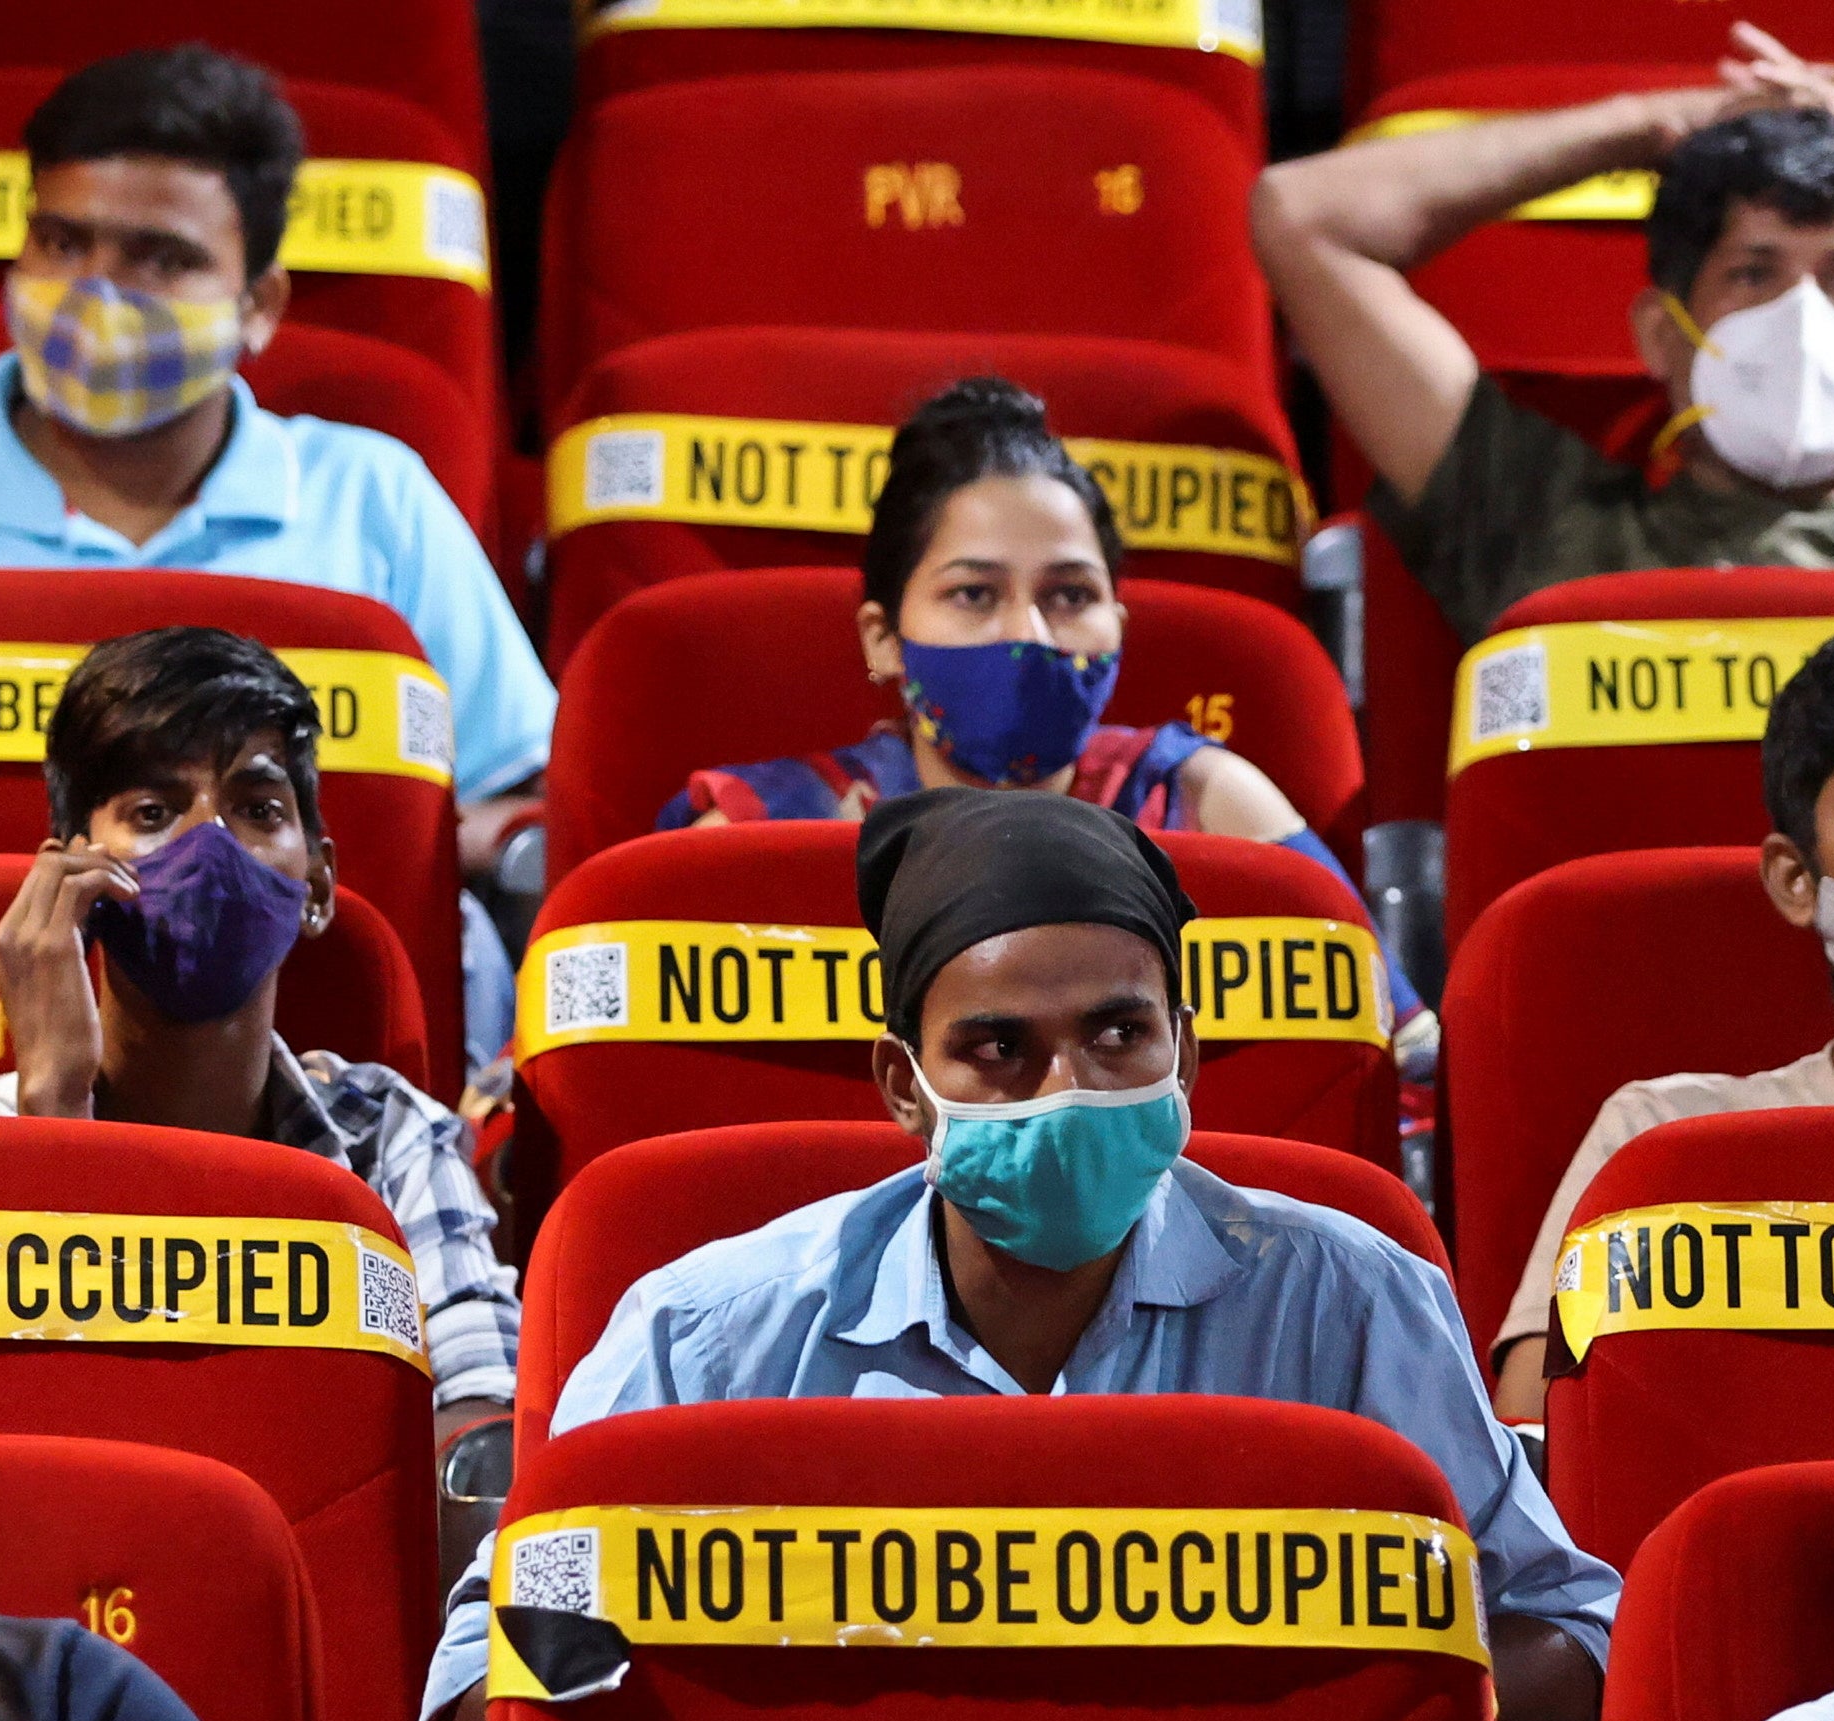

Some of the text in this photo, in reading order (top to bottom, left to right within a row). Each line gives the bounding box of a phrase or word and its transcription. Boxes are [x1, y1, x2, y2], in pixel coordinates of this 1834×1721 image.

[288, 187, 394, 239] PIED
[865, 164, 964, 229] PVR
[688, 440, 803, 504] NOT
[1587, 657, 1688, 711] NOT
[1719, 656, 1778, 708] TO
[1187, 692, 1233, 743] 15
[660, 940, 1356, 1026] NOT TO UPIED
[1607, 1223, 1752, 1312] NOT
[637, 1528, 1453, 1631] NOT TO BE OCCUPIED
[82, 1587, 134, 1644] 16
